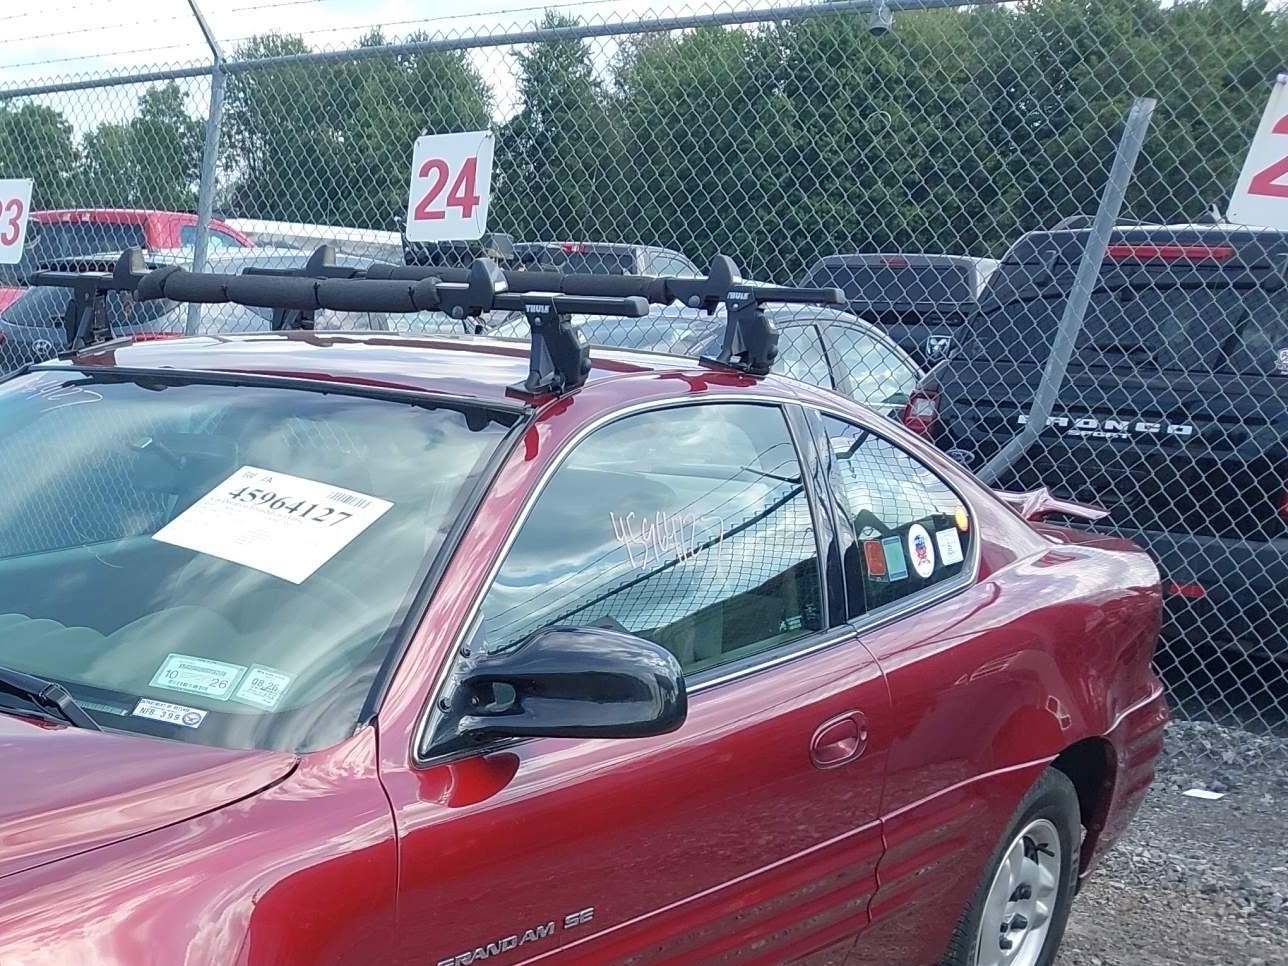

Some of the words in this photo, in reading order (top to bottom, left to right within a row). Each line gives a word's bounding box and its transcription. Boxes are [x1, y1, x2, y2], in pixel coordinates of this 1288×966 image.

[414, 156, 481, 221] 24
[525, 304, 550, 313] THULE
[1067, 429, 1133, 439] SPORT
[229, 485, 353, 527] 45964127
[164, 669, 179, 679] 10
[209, 678, 229, 689] 26
[564, 907, 595, 929] SE
